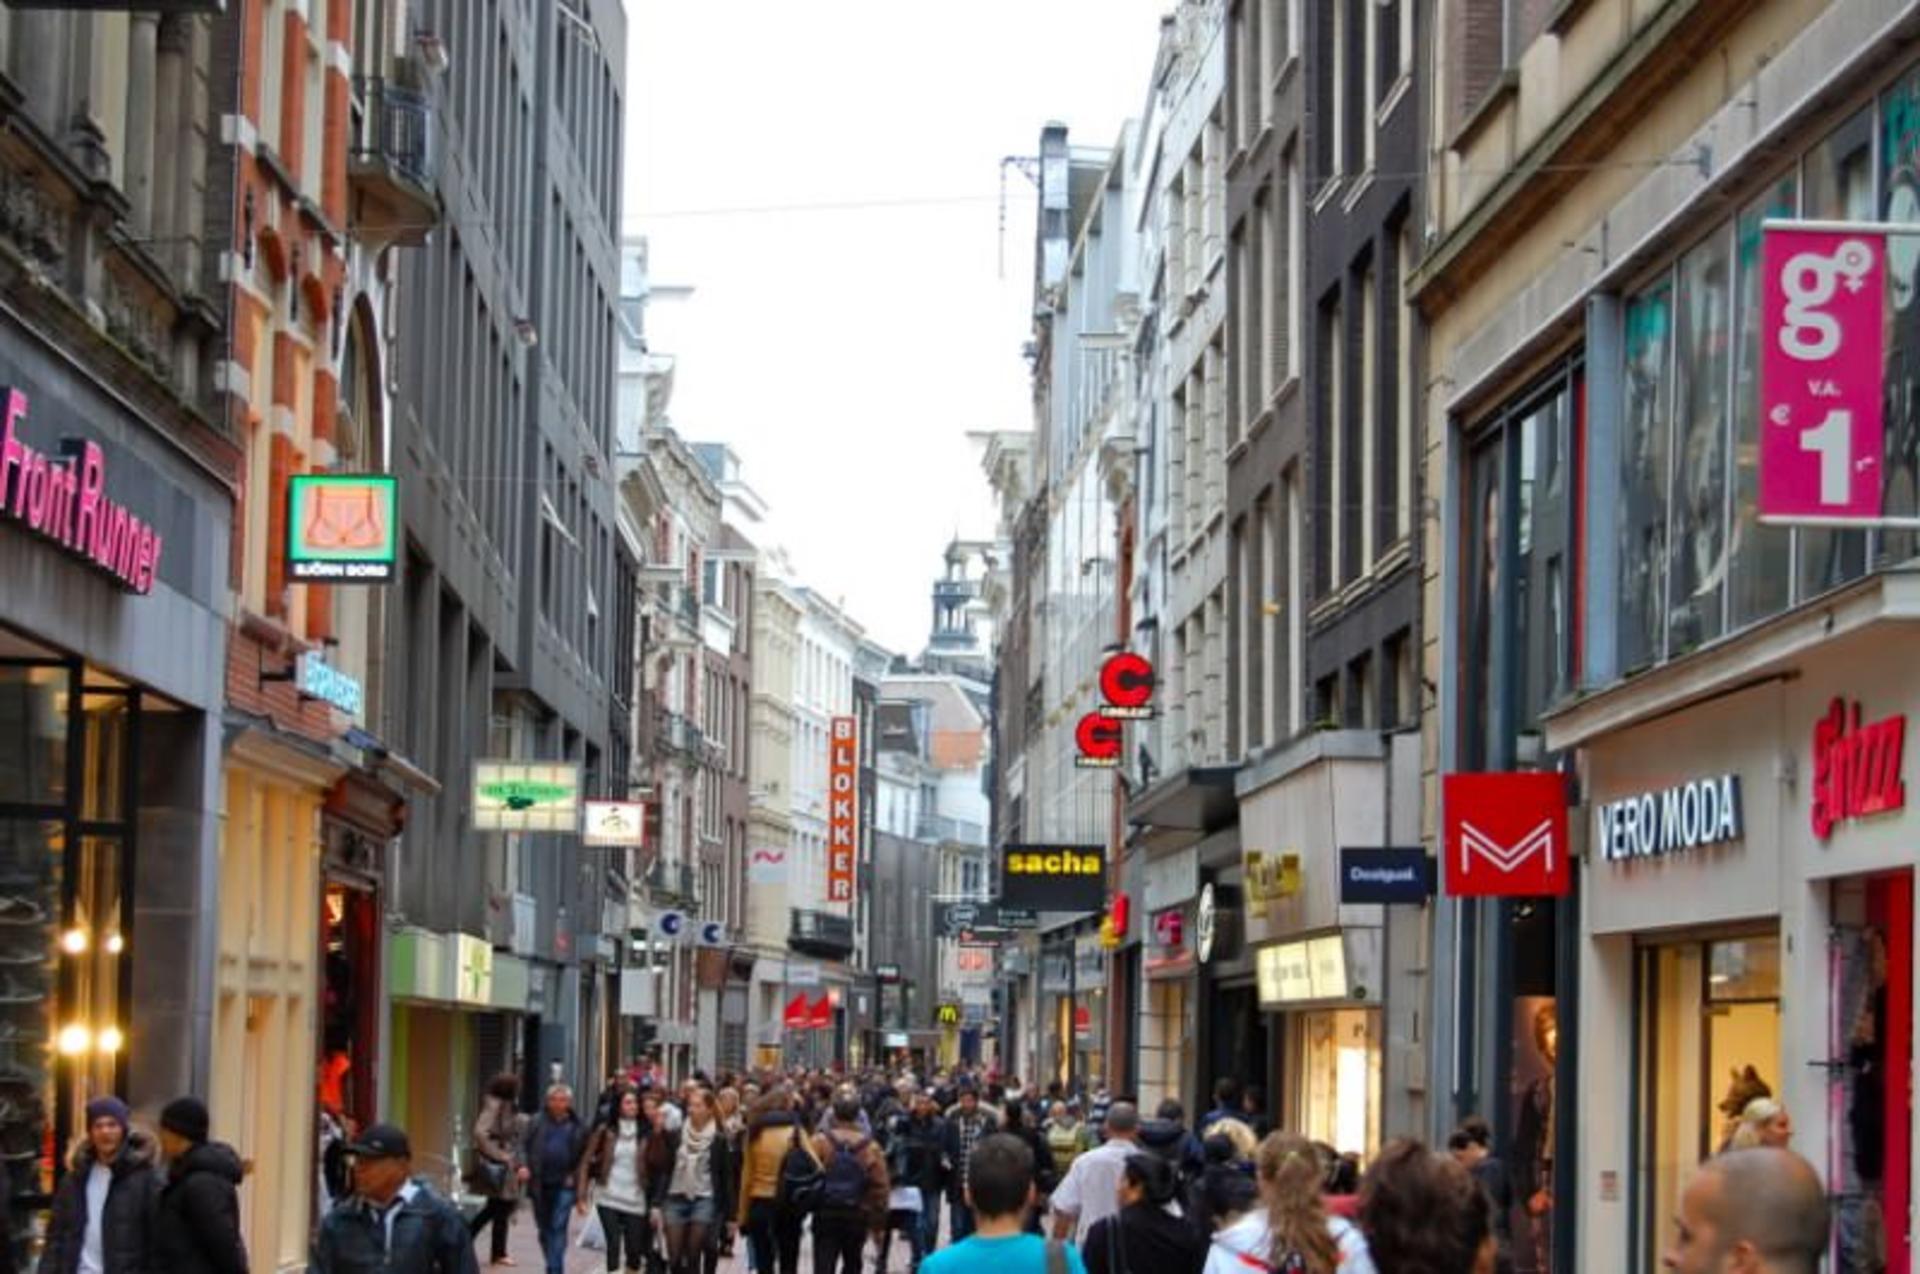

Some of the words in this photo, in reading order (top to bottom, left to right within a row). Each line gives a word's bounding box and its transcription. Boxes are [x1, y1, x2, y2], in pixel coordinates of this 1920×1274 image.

[1807, 379, 1842, 397] V.A.
[833, 721, 851, 898] BLOKKER
[1598, 792, 1656, 859] VERO
[1660, 774, 1737, 851] MODA
[1007, 850, 1101, 875] sacha
